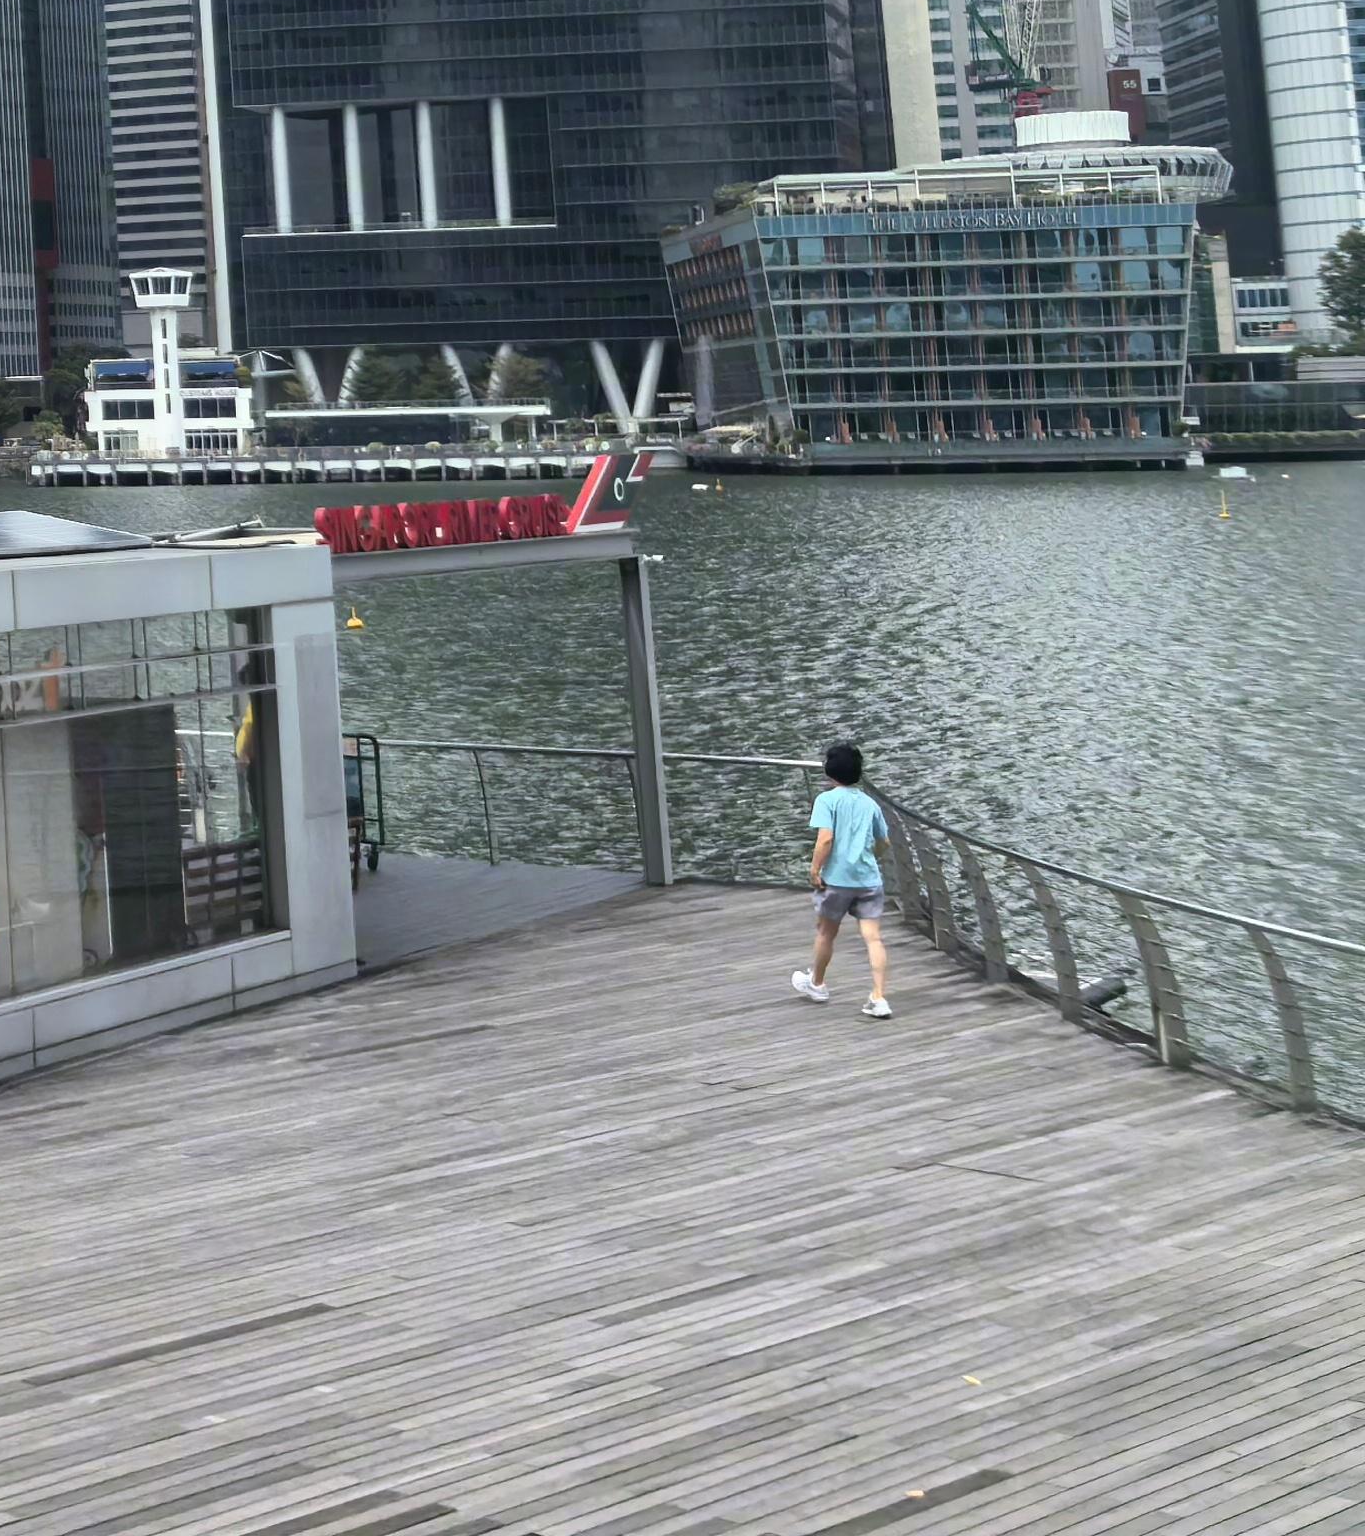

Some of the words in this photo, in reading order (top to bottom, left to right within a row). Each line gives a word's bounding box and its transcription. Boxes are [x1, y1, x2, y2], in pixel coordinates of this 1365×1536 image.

[871, 215, 896, 231] THE
[995, 213, 1020, 227] BAY
[1027, 211, 1077, 226] HOTEL
